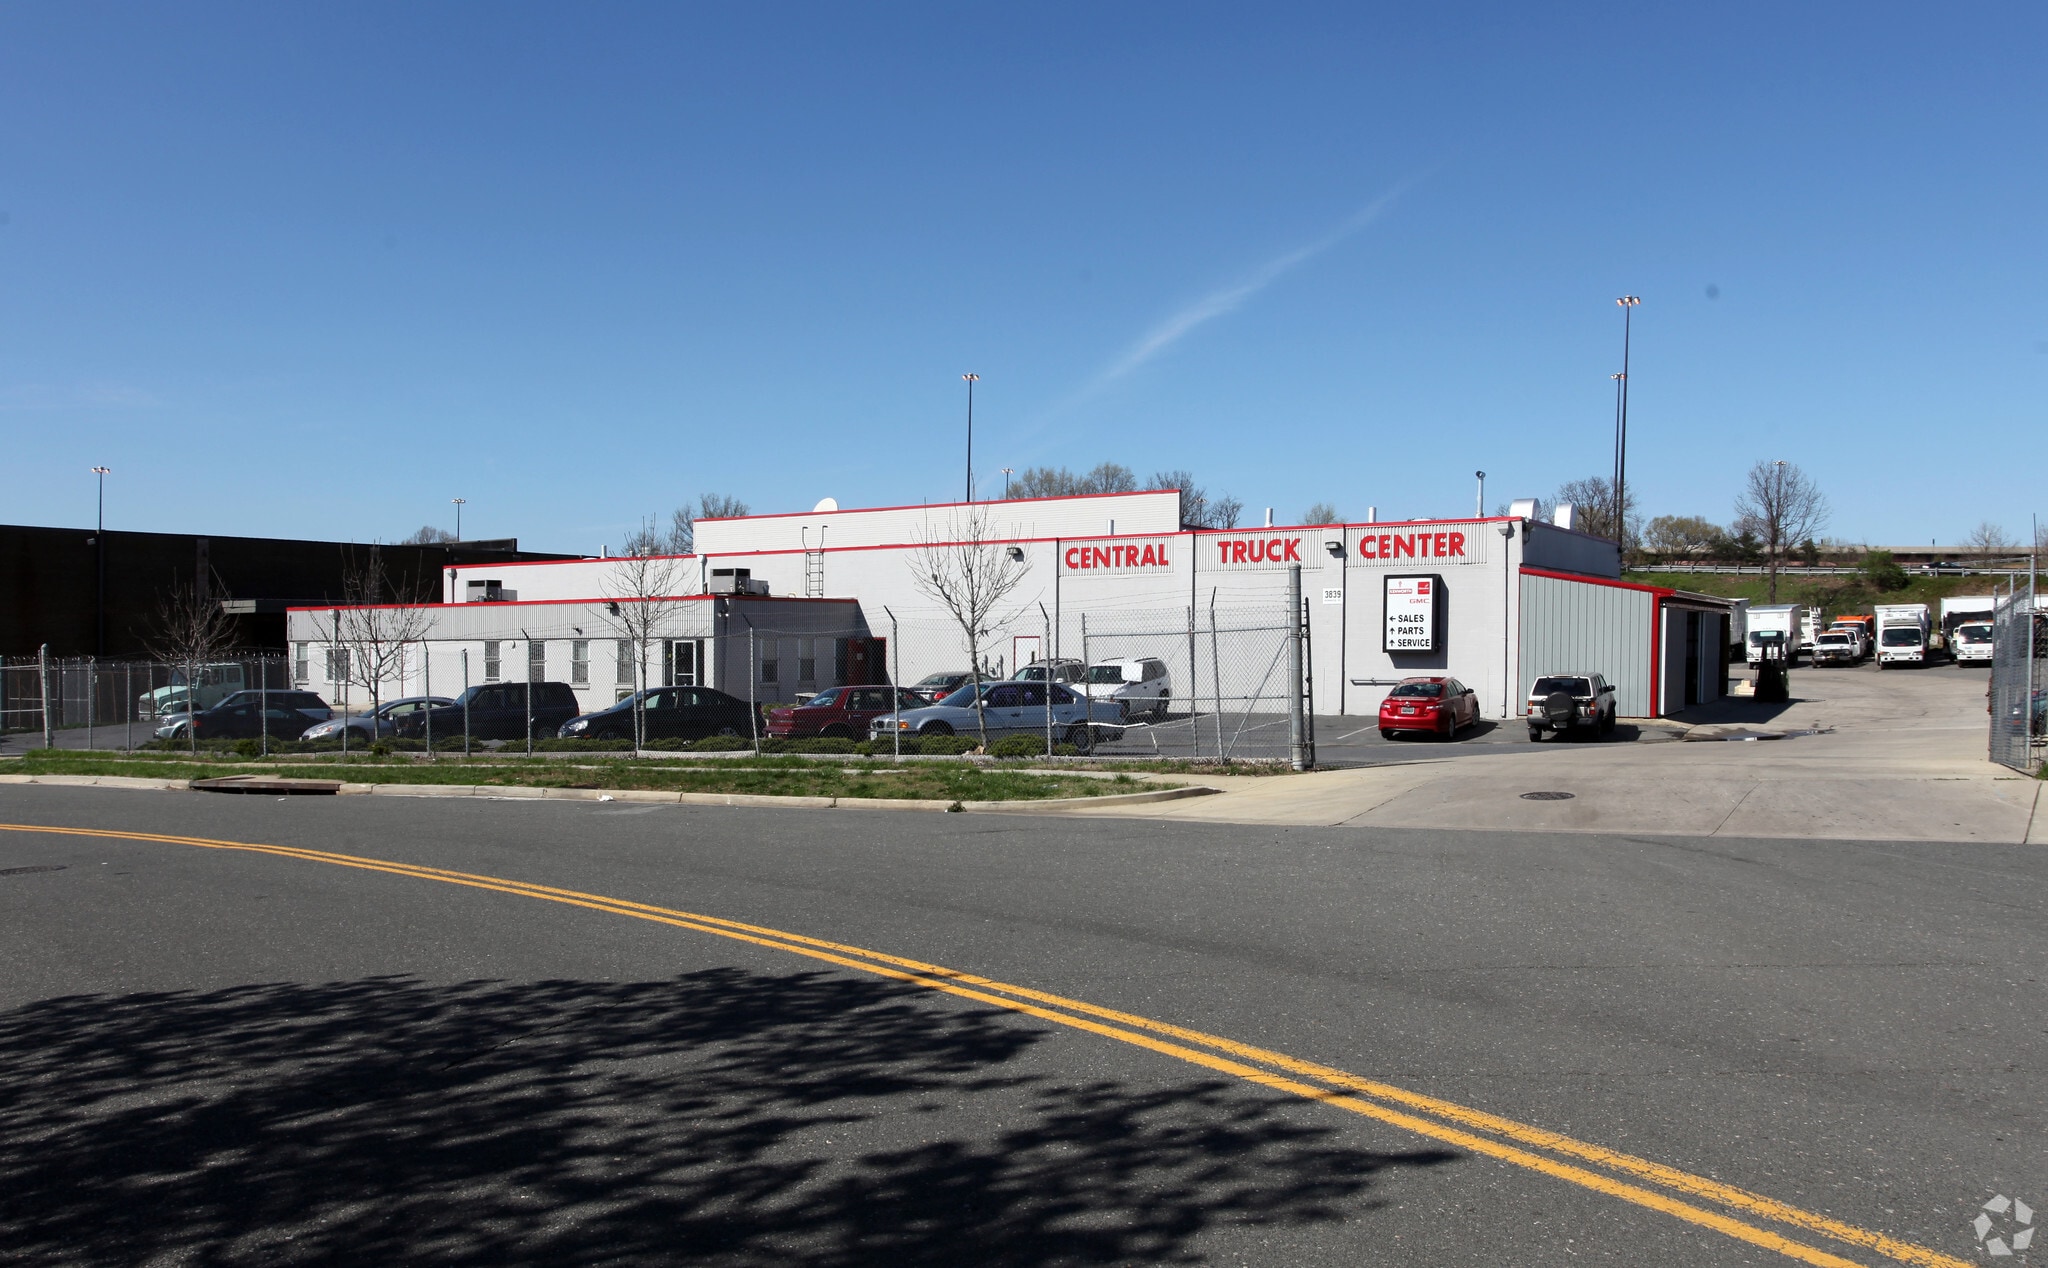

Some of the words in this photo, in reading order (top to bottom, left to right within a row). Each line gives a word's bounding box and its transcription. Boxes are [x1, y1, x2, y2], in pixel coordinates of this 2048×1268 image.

[1065, 544, 1169, 569] CENTRAL
[1218, 538, 1301, 563] TRUCK
[1359, 532, 1465, 559] CENTER
[1325, 590, 1341, 598] 3839
[1398, 614, 1424, 622] SALES
[1397, 626, 1424, 635] PARTS
[1397, 638, 1430, 647] SERVICE
